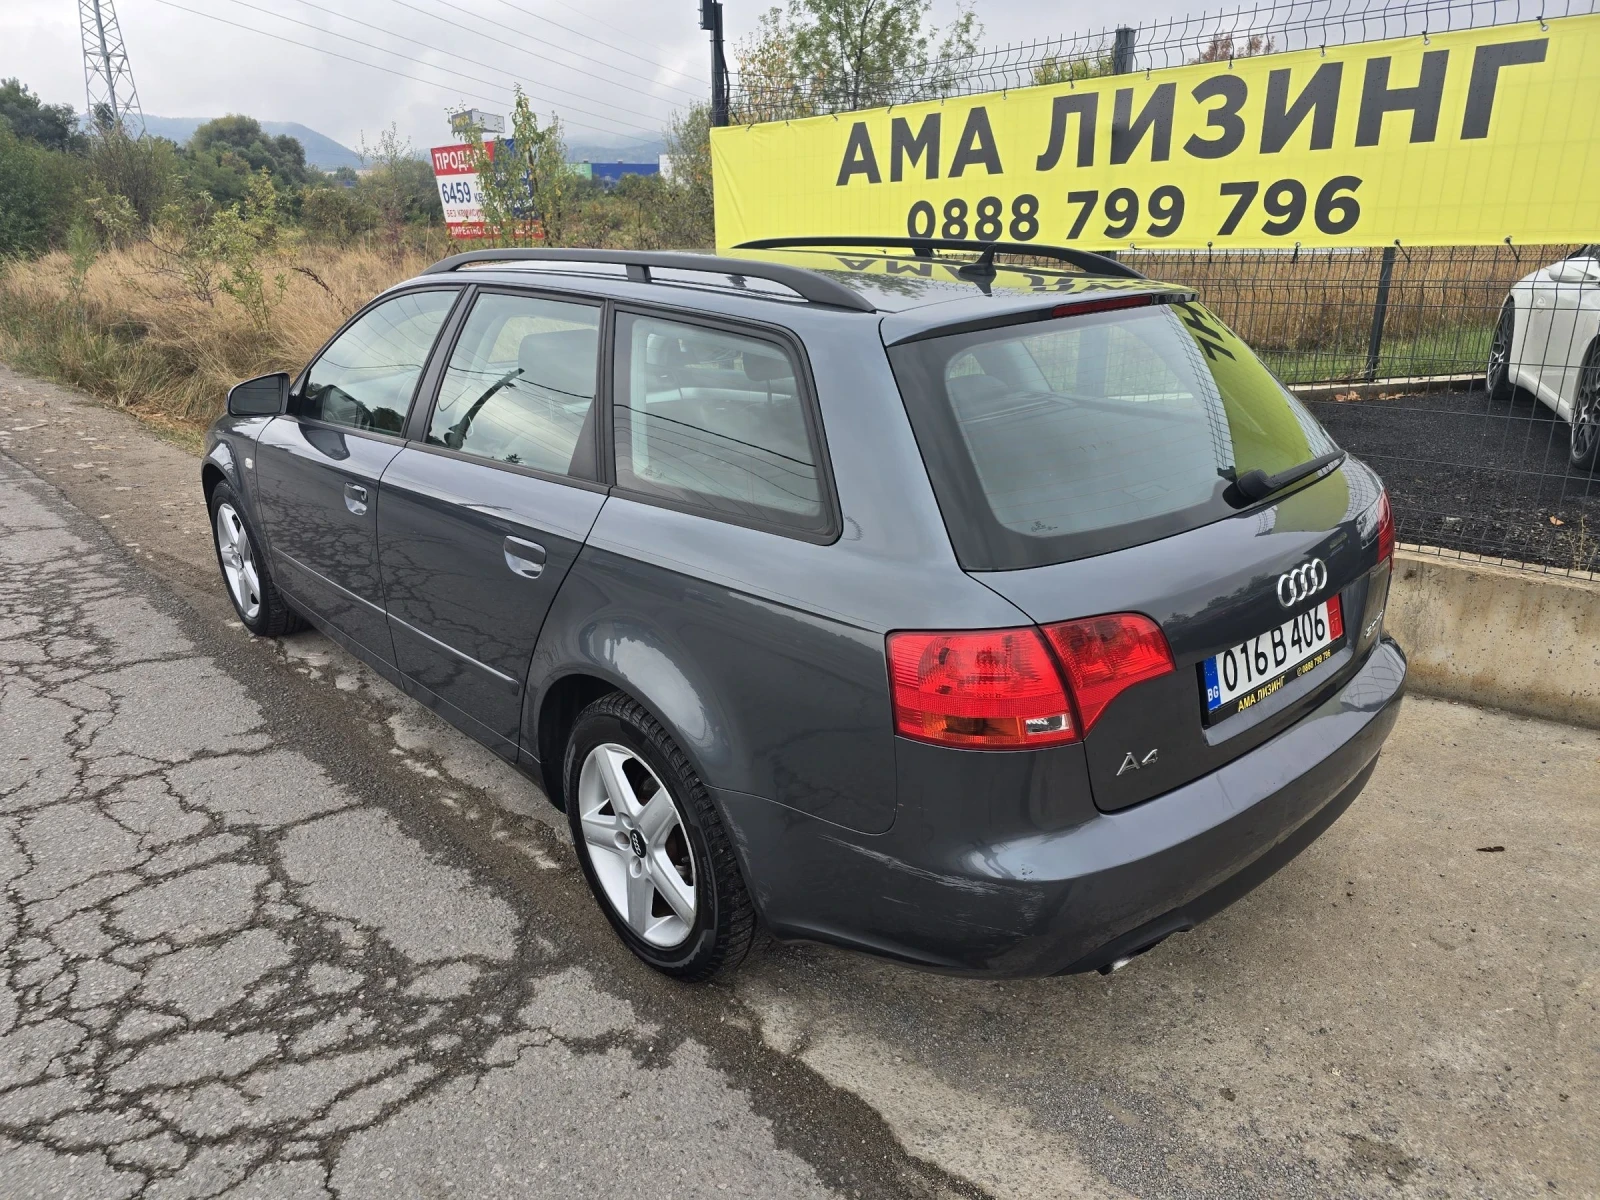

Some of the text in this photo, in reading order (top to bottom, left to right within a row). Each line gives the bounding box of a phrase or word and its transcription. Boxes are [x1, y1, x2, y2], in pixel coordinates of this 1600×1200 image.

[837, 38, 1549, 186] АМА ЛИЗИНГ
[441, 181, 472, 204] 6459
[446, 209, 457, 218] БЕЗ
[907, 176, 1363, 242] 0888 799 796
[451, 225, 482, 236] ДИРЕКТНО
[1207, 686, 1220, 702] BG
[1222, 637, 1269, 692] 016
[1271, 626, 1287, 668] B
[1291, 607, 1326, 654] 406
[1302, 649, 1331, 673] 0888 799 796
[1238, 675, 1285, 713] АМА ЛИЗИНГ
[1116, 748, 1158, 776] A4
